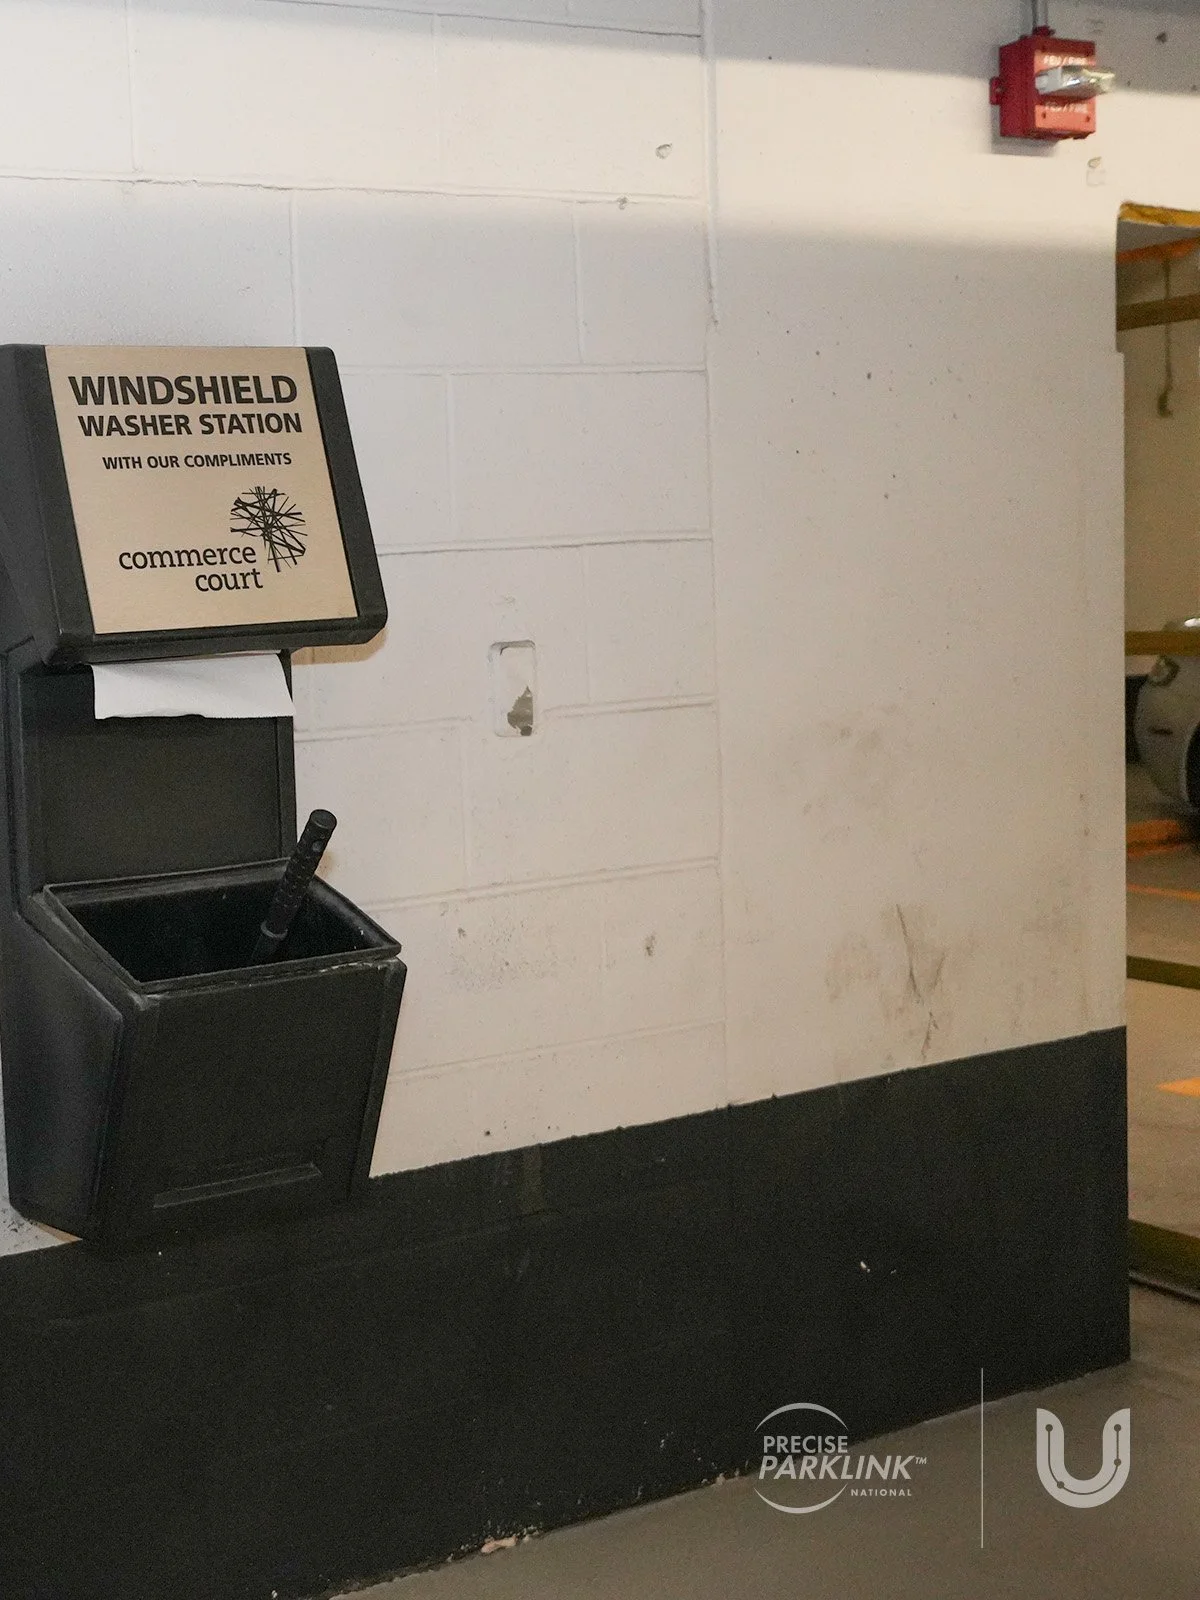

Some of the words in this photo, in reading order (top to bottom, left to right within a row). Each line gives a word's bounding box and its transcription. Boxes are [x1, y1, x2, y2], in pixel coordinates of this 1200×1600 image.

[68, 375, 298, 406] WINDSHIELD
[78, 414, 193, 437] WASHER
[199, 412, 303, 435] STATION
[102, 456, 143, 470] WITH
[146, 455, 180, 469] OUR
[184, 452, 292, 468] COMPLIMENTS
[119, 546, 257, 570] commerce
[195, 568, 264, 592] court
